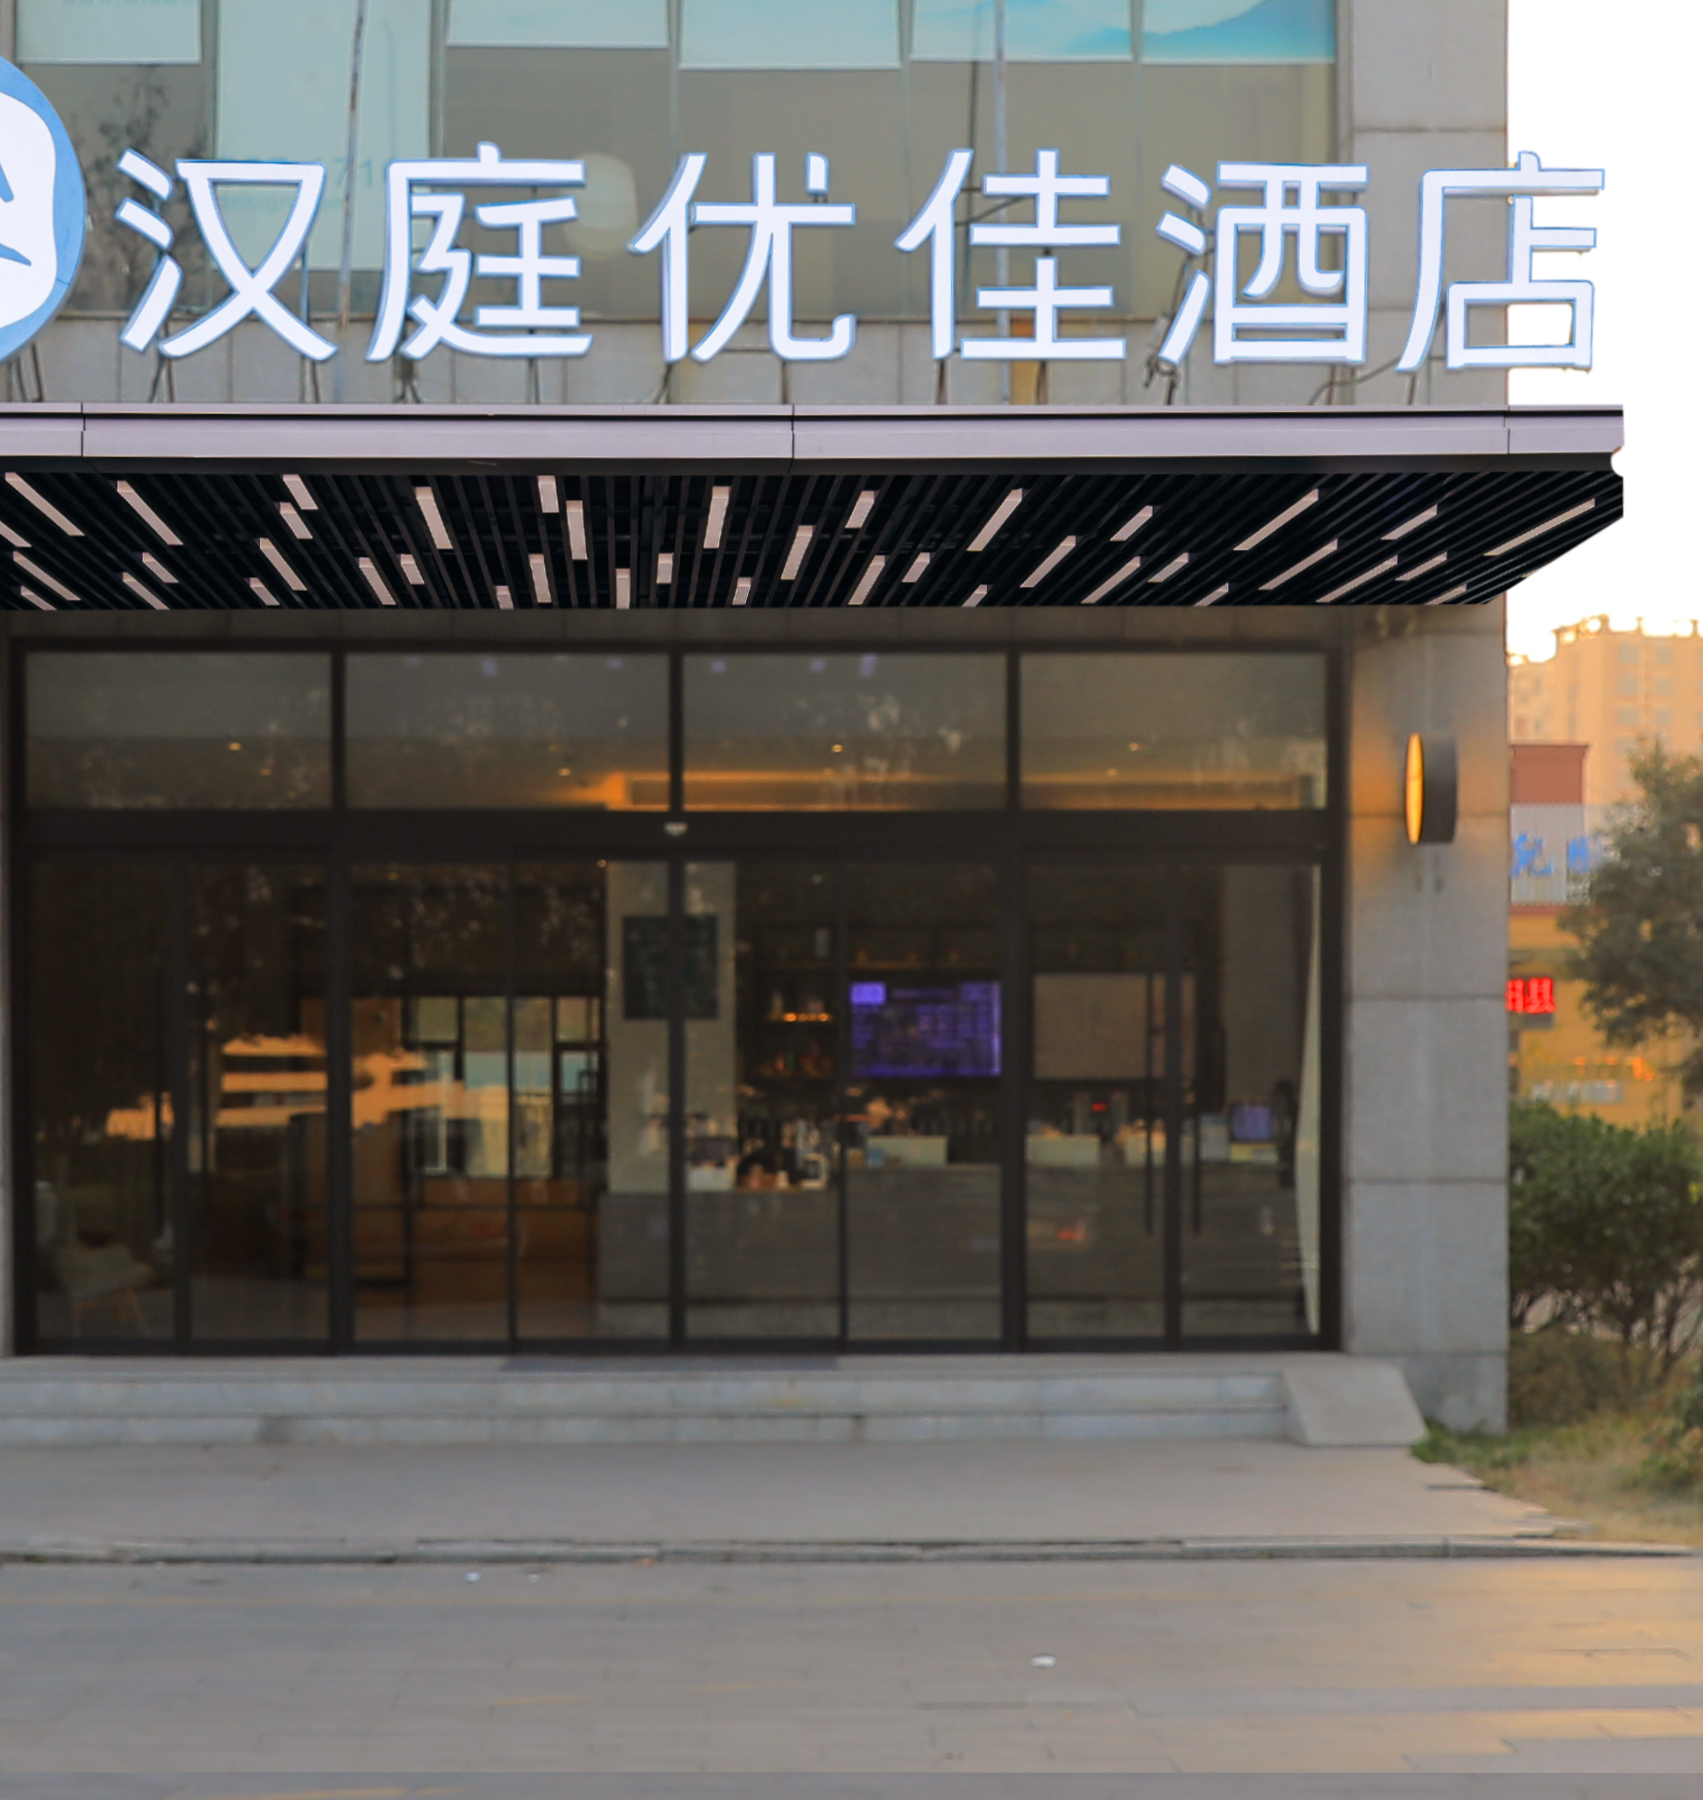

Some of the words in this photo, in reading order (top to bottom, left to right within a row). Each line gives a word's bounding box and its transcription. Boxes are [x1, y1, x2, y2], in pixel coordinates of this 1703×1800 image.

[115, 142, 1605, 372] 汉庭优佳酒店
